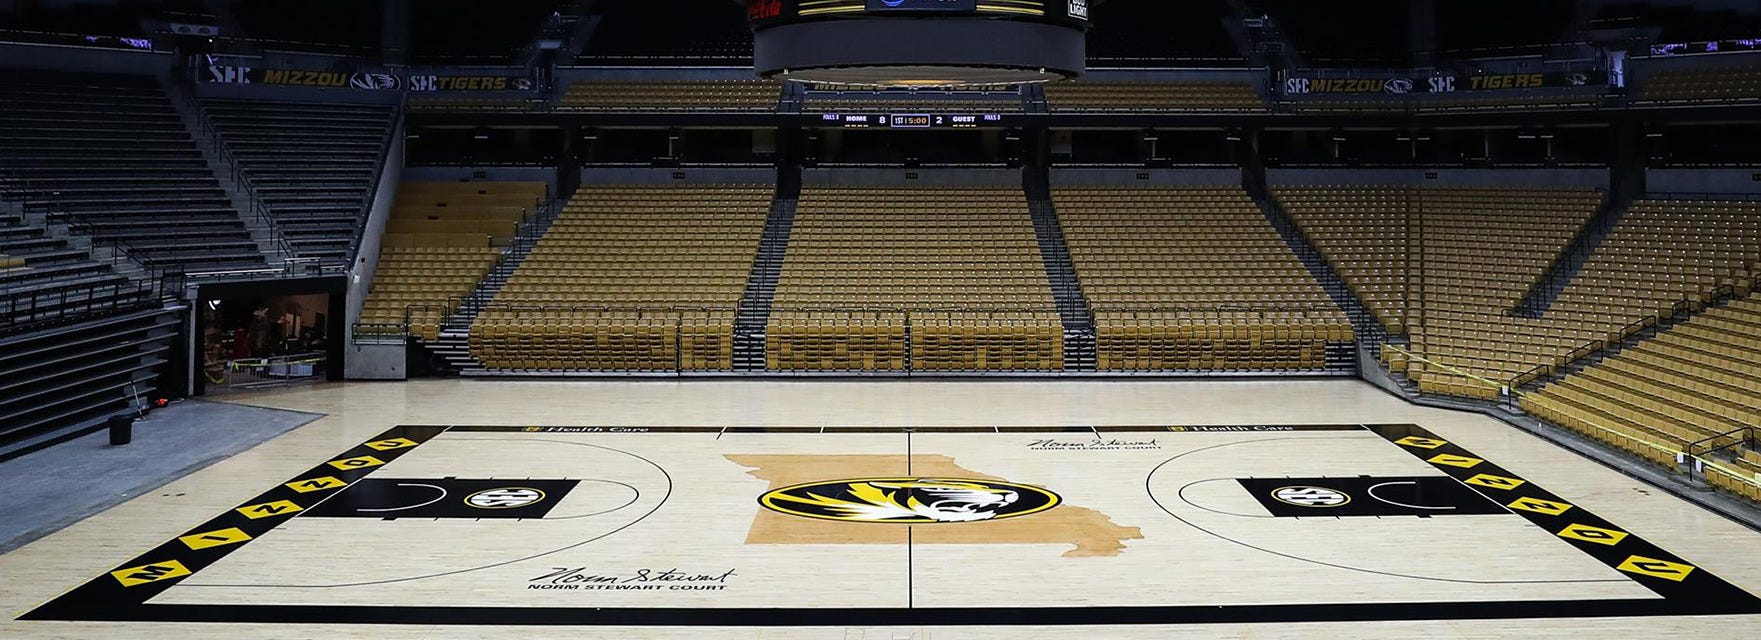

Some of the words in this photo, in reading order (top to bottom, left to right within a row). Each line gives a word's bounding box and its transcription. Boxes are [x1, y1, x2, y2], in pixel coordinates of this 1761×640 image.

[1070, 3, 1087, 17] LIGHT
[263, 69, 347, 87] MIZZOU
[438, 76, 507, 90] TIGERS
[1470, 73, 1543, 90] TIGERS
[1310, 78, 1384, 93] MIZZOU
[879, 116, 886, 124] 8
[895, 117, 903, 125] 1ST
[908, 117, 927, 125] 5:00
[936, 116, 942, 124] 2
[621, 567, 738, 583] Stewart
